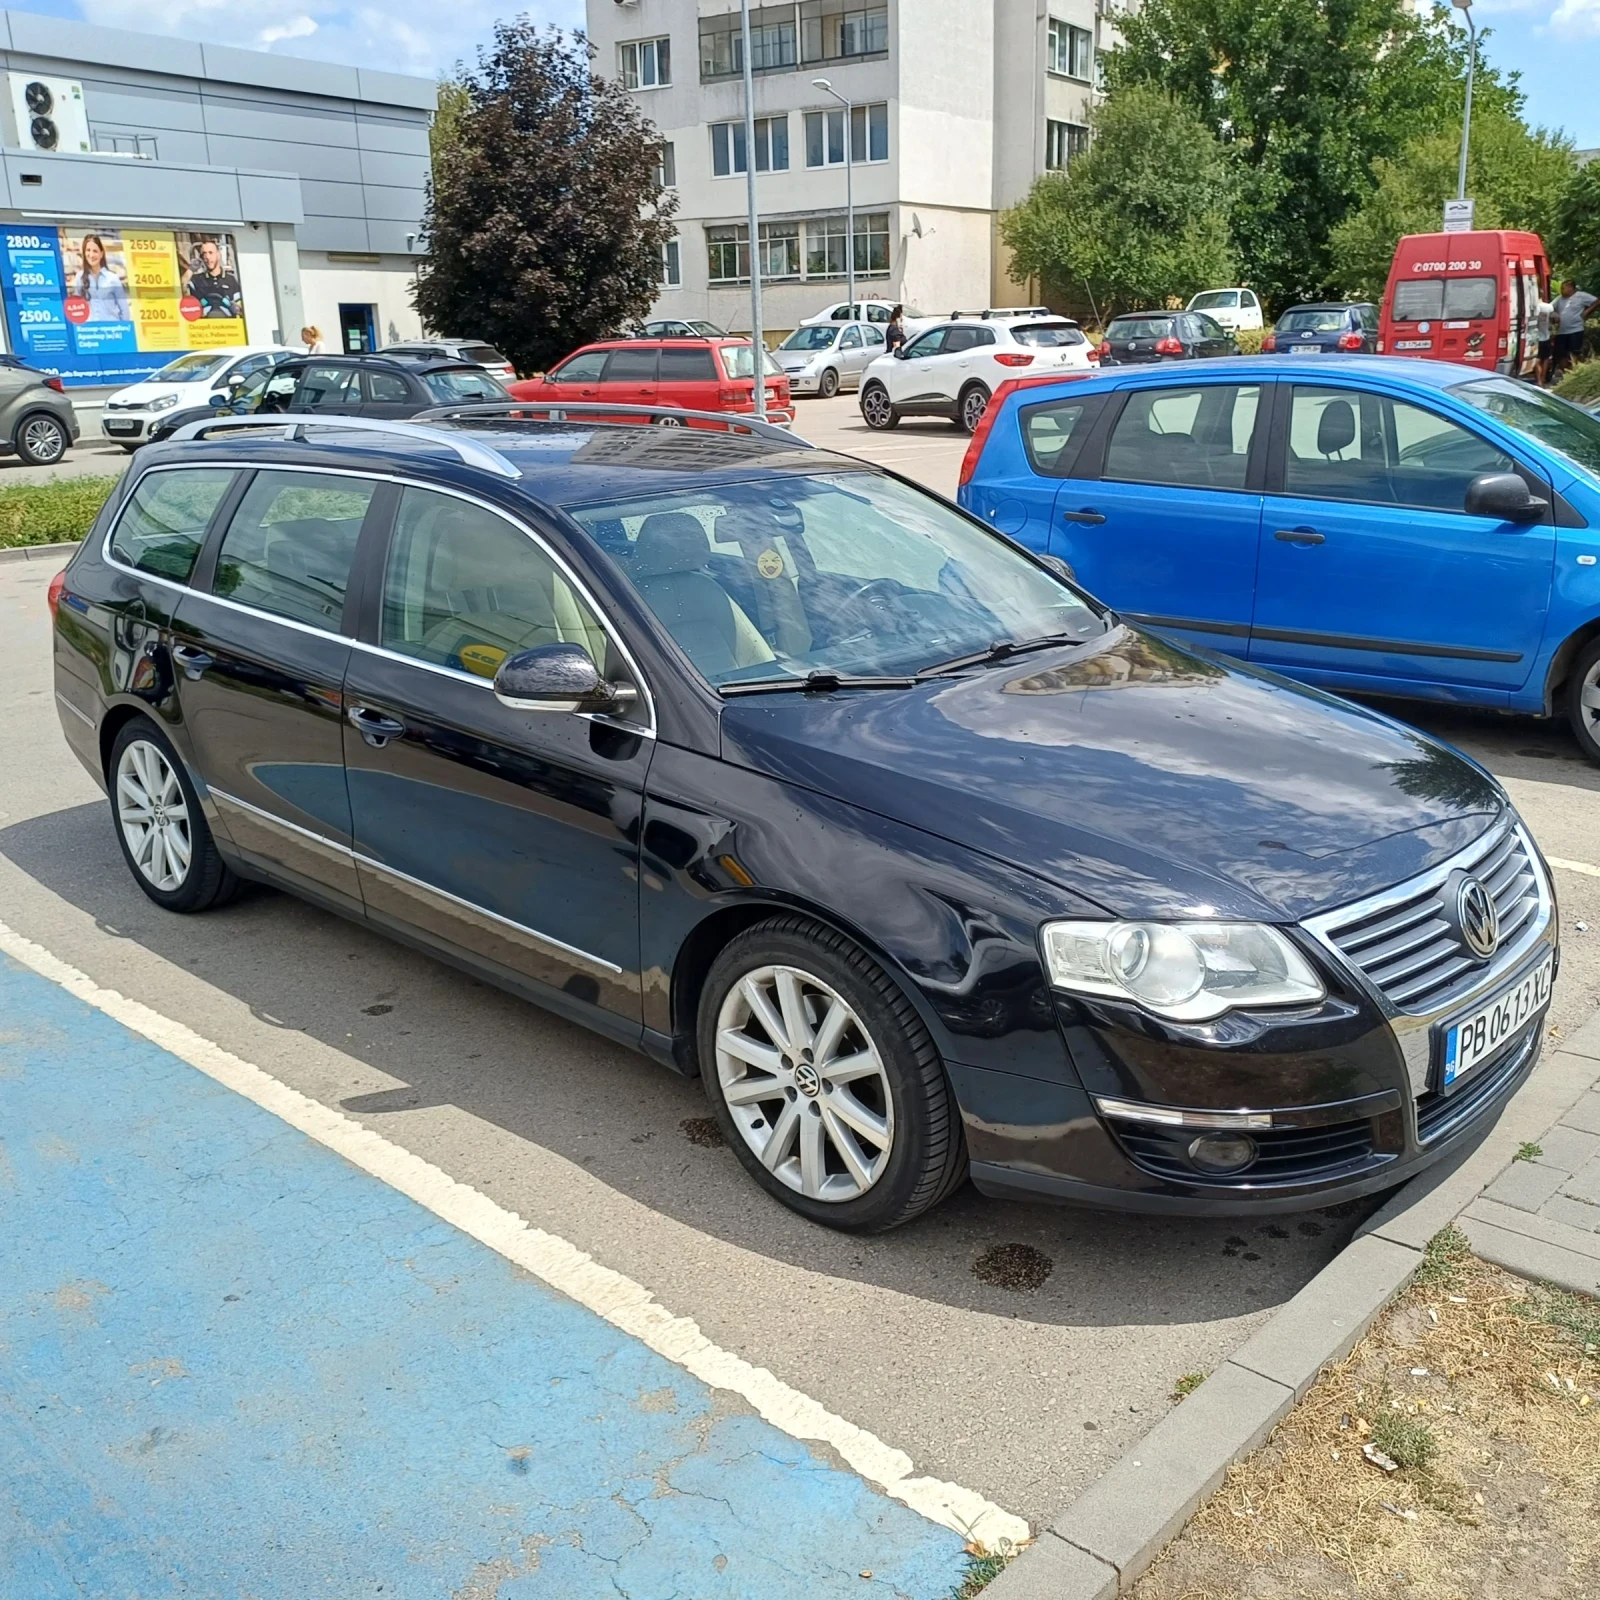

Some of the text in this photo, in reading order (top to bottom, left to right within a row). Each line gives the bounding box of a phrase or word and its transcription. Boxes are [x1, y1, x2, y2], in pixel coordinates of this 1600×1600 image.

[6, 235, 40, 249] 2800
[130, 240, 157, 250] 2650
[1422, 260, 1482, 272] 0700 200 30
[12, 273, 45, 286] 2650
[135, 274, 162, 285] 2400
[19, 310, 51, 323] 2500
[140, 309, 167, 320] 2200
[1458, 960, 1551, 1069] PB 0613 XC
